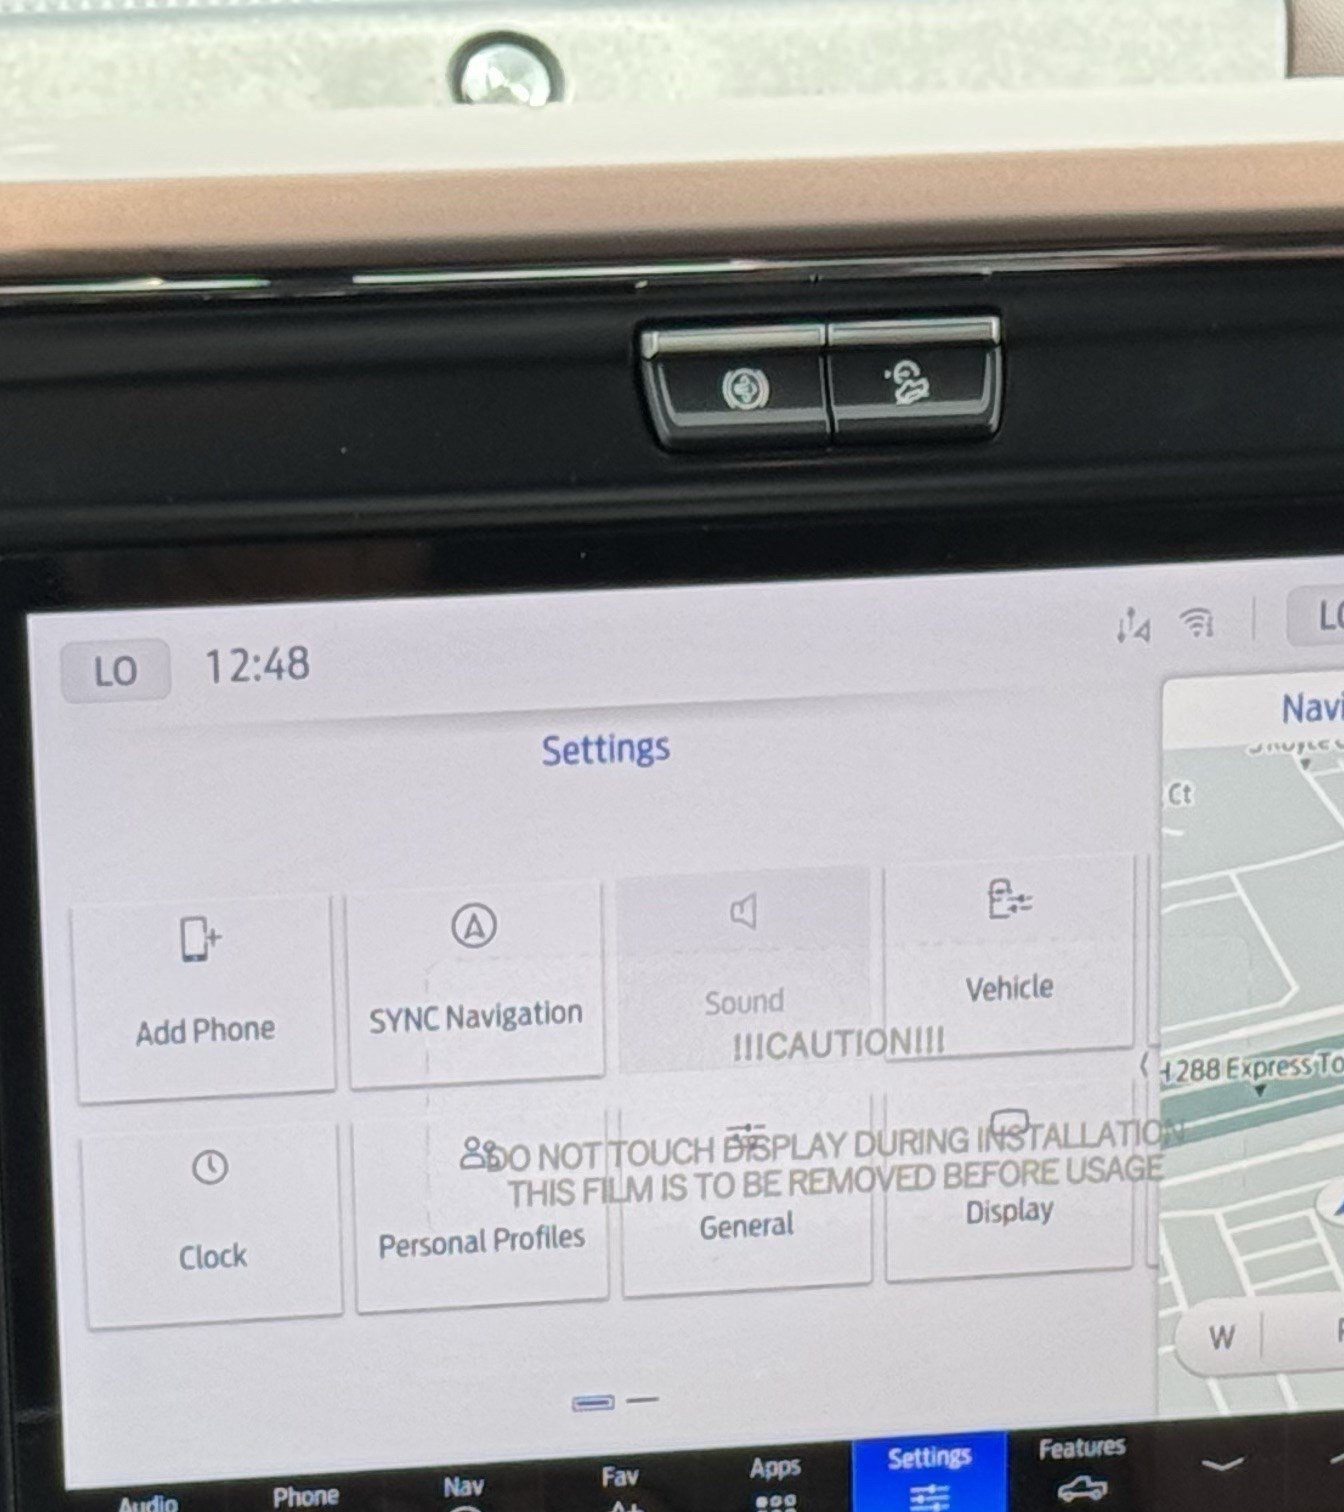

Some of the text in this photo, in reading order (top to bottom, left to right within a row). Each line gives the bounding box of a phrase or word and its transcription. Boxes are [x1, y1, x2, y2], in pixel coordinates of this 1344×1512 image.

[94, 655, 137, 687] LO
[206, 645, 310, 684] 12:48
[542, 734, 671, 769] Settings
[705, 988, 785, 1016] Sound
[967, 974, 1054, 1003] Vehicle
[136, 1016, 276, 1046] Add Phone
[368, 1000, 584, 1034] SYNC Navigation
[1226, 1056, 1311, 1085] Express
[488, 1117, 1186, 1172] DO NOT TOUCH DISPLAY DURING INSTALLATION
[508, 1153, 1164, 1208] THIS FILM IS TO BE REMOVED BEFORE USAGE
[699, 1211, 794, 1241] General
[966, 1198, 1054, 1227] Display
[179, 1243, 248, 1270] Clock
[378, 1225, 586, 1259] Personal Profiles
[1208, 1323, 1236, 1351] W
[888, 1444, 972, 1473] Settings
[1039, 1436, 1126, 1462] Features
[602, 1467, 640, 1487] Fav
[750, 1457, 802, 1482] Apps
[273, 1486, 340, 1509] Phone
[444, 1477, 484, 1498] Nav
